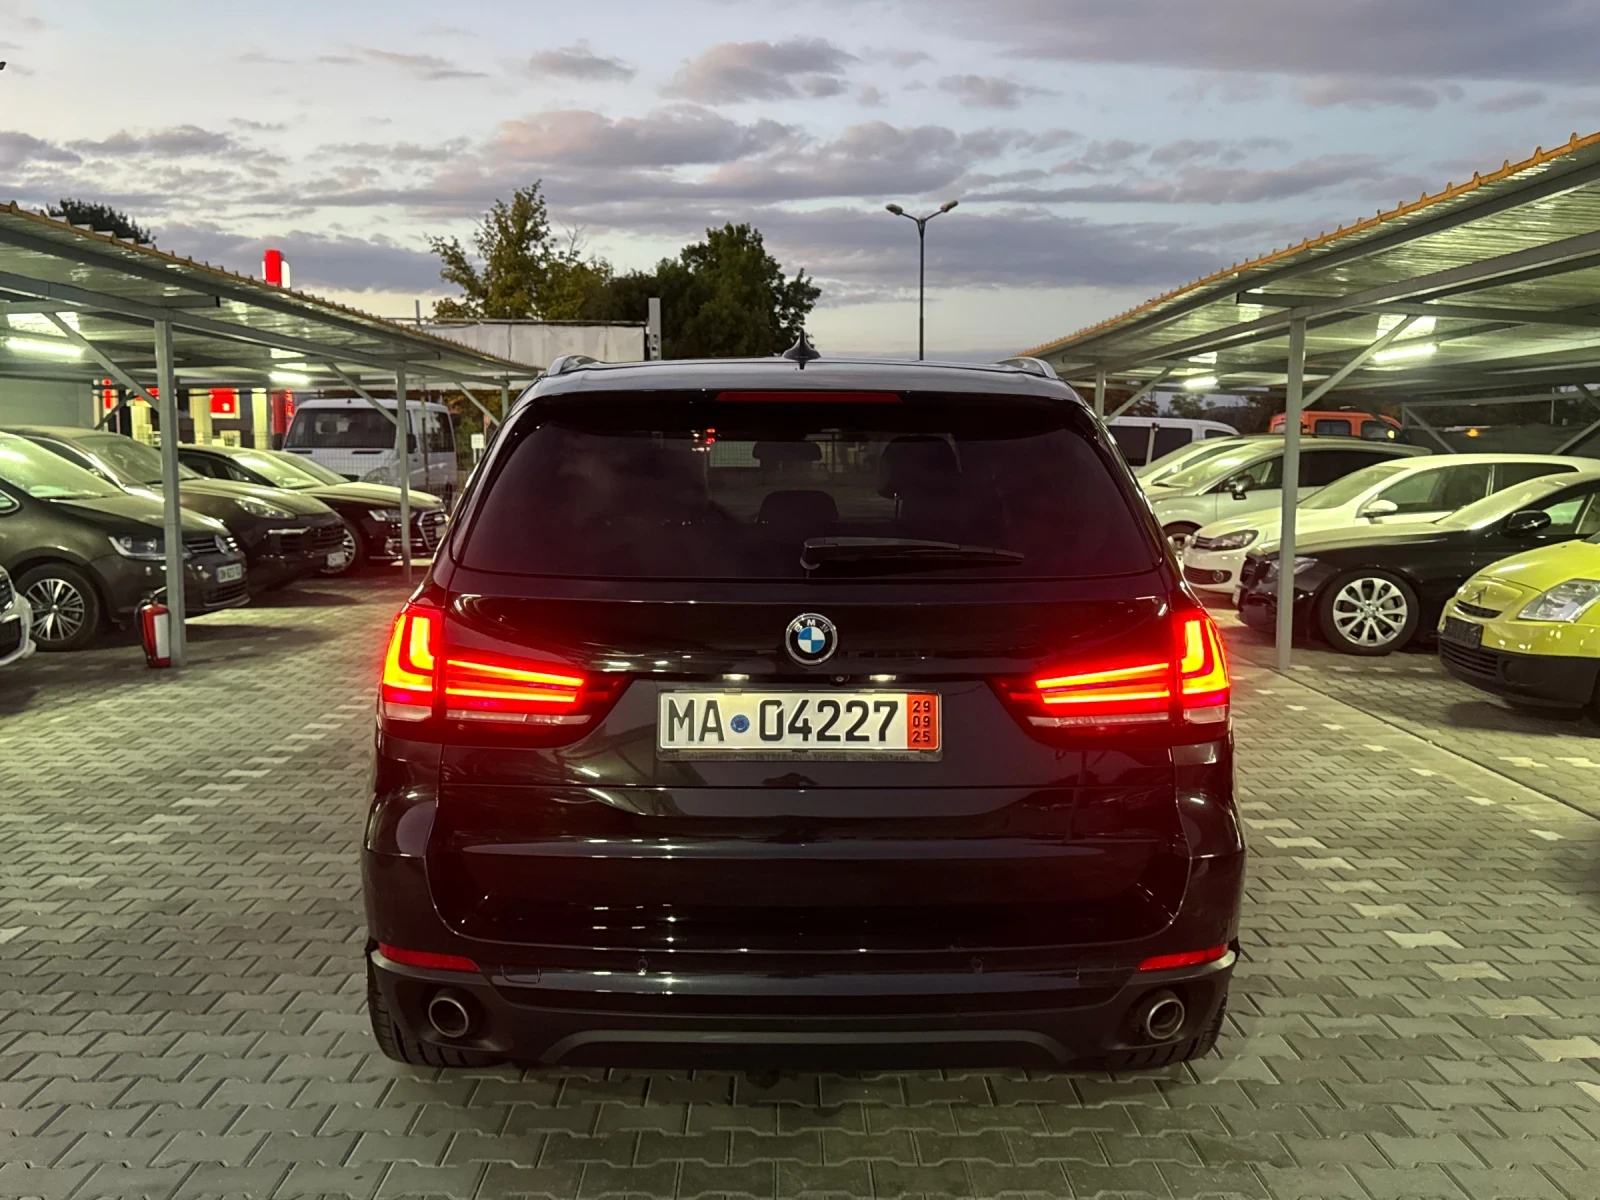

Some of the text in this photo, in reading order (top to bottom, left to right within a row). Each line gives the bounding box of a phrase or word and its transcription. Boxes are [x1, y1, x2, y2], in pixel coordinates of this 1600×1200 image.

[794, 619, 830, 633] BMW
[912, 700, 930, 713] 29
[668, 699, 899, 742] MA 04227
[912, 715, 930, 728] 09
[912, 730, 930, 743] 25
